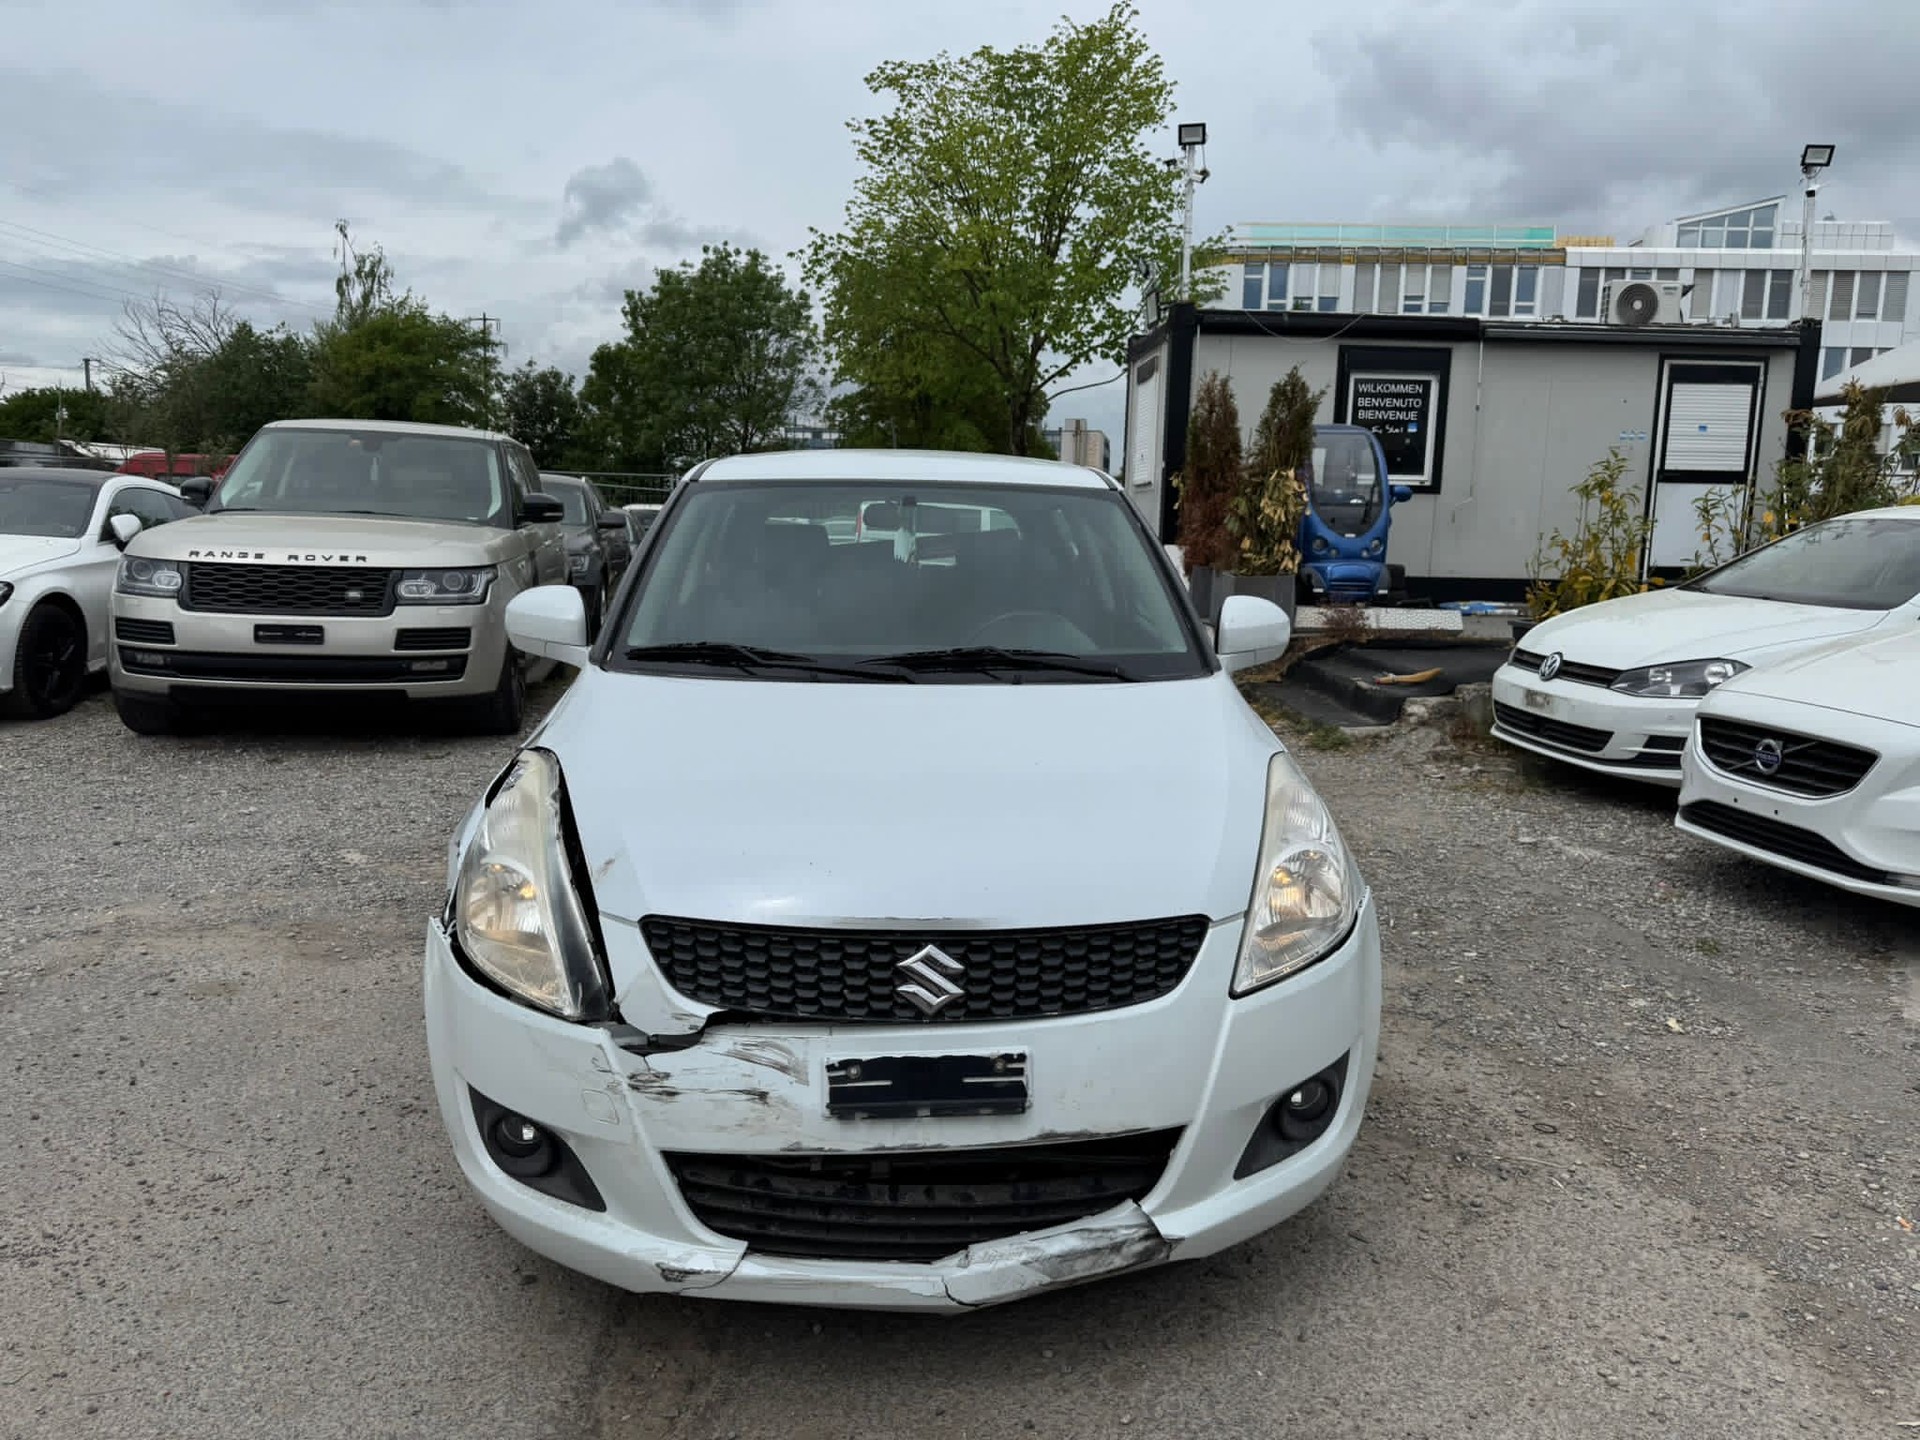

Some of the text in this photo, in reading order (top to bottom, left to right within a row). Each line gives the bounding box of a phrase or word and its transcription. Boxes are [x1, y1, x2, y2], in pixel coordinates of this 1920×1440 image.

[1358, 383, 1423, 394] WILKOMMEN
[1358, 397, 1422, 408] BENVENUTO
[1358, 410, 1418, 420] BIENVENUE
[188, 550, 367, 563] RANGE ROVER
